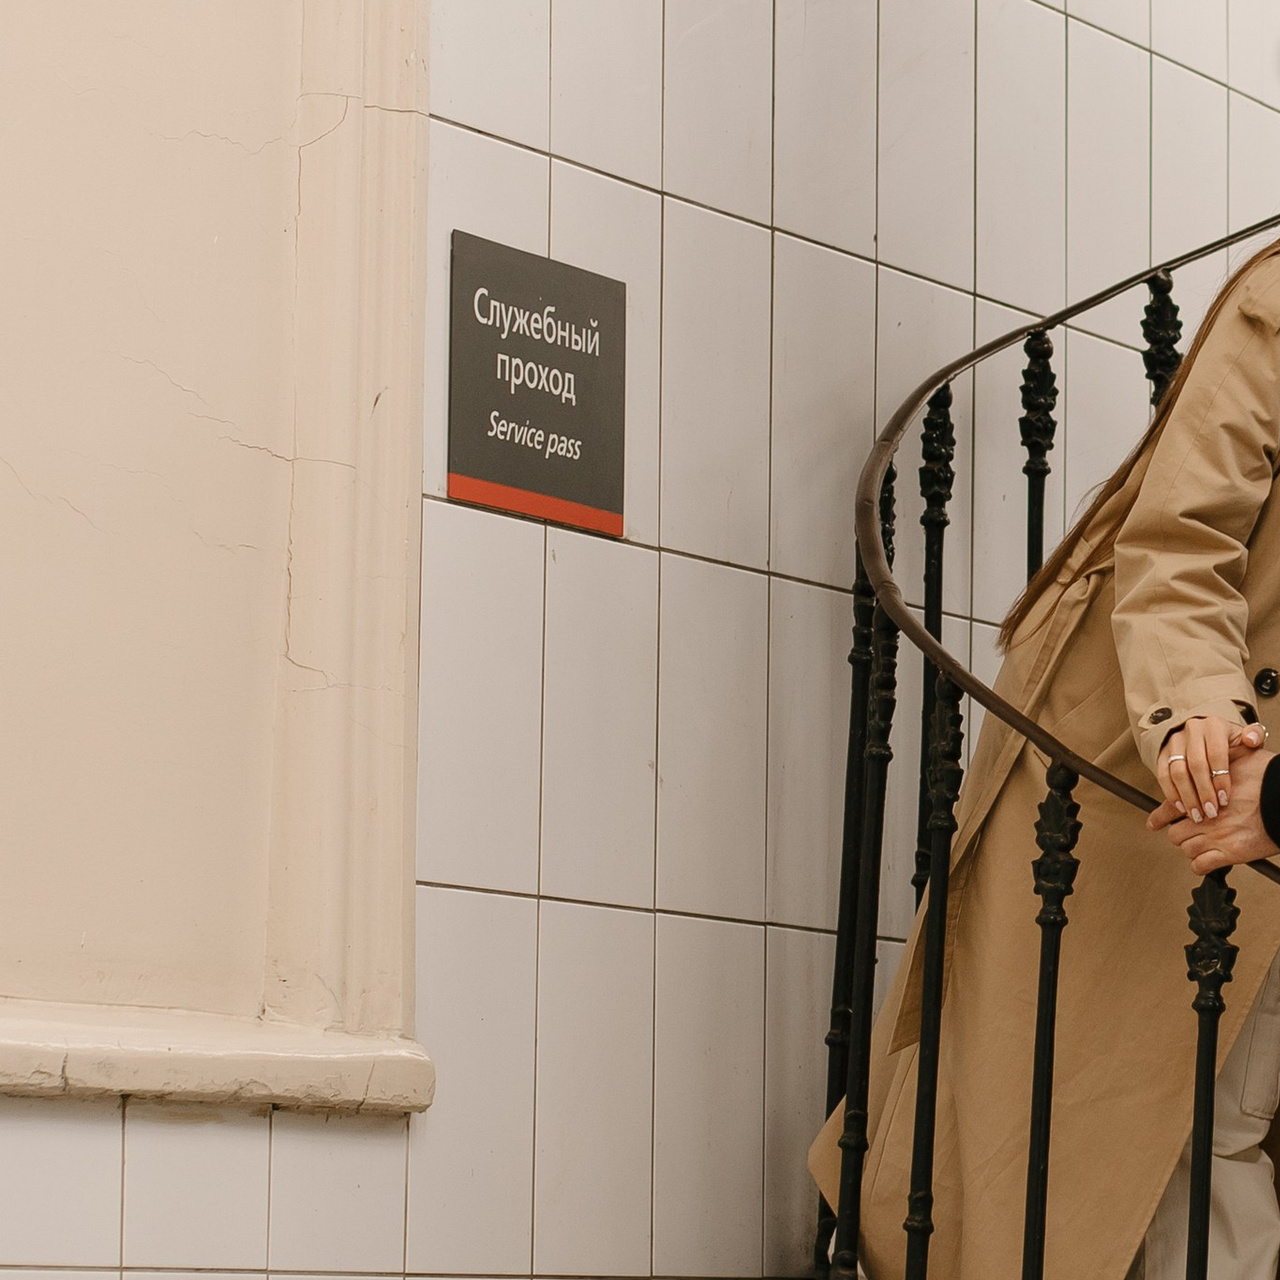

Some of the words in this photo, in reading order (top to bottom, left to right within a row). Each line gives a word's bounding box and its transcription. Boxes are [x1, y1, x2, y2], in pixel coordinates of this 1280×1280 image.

[473, 287, 600, 356] Служебный
[496, 353, 576, 406] проход
[488, 410, 544, 450] Service
[545, 433, 582, 460] pass
